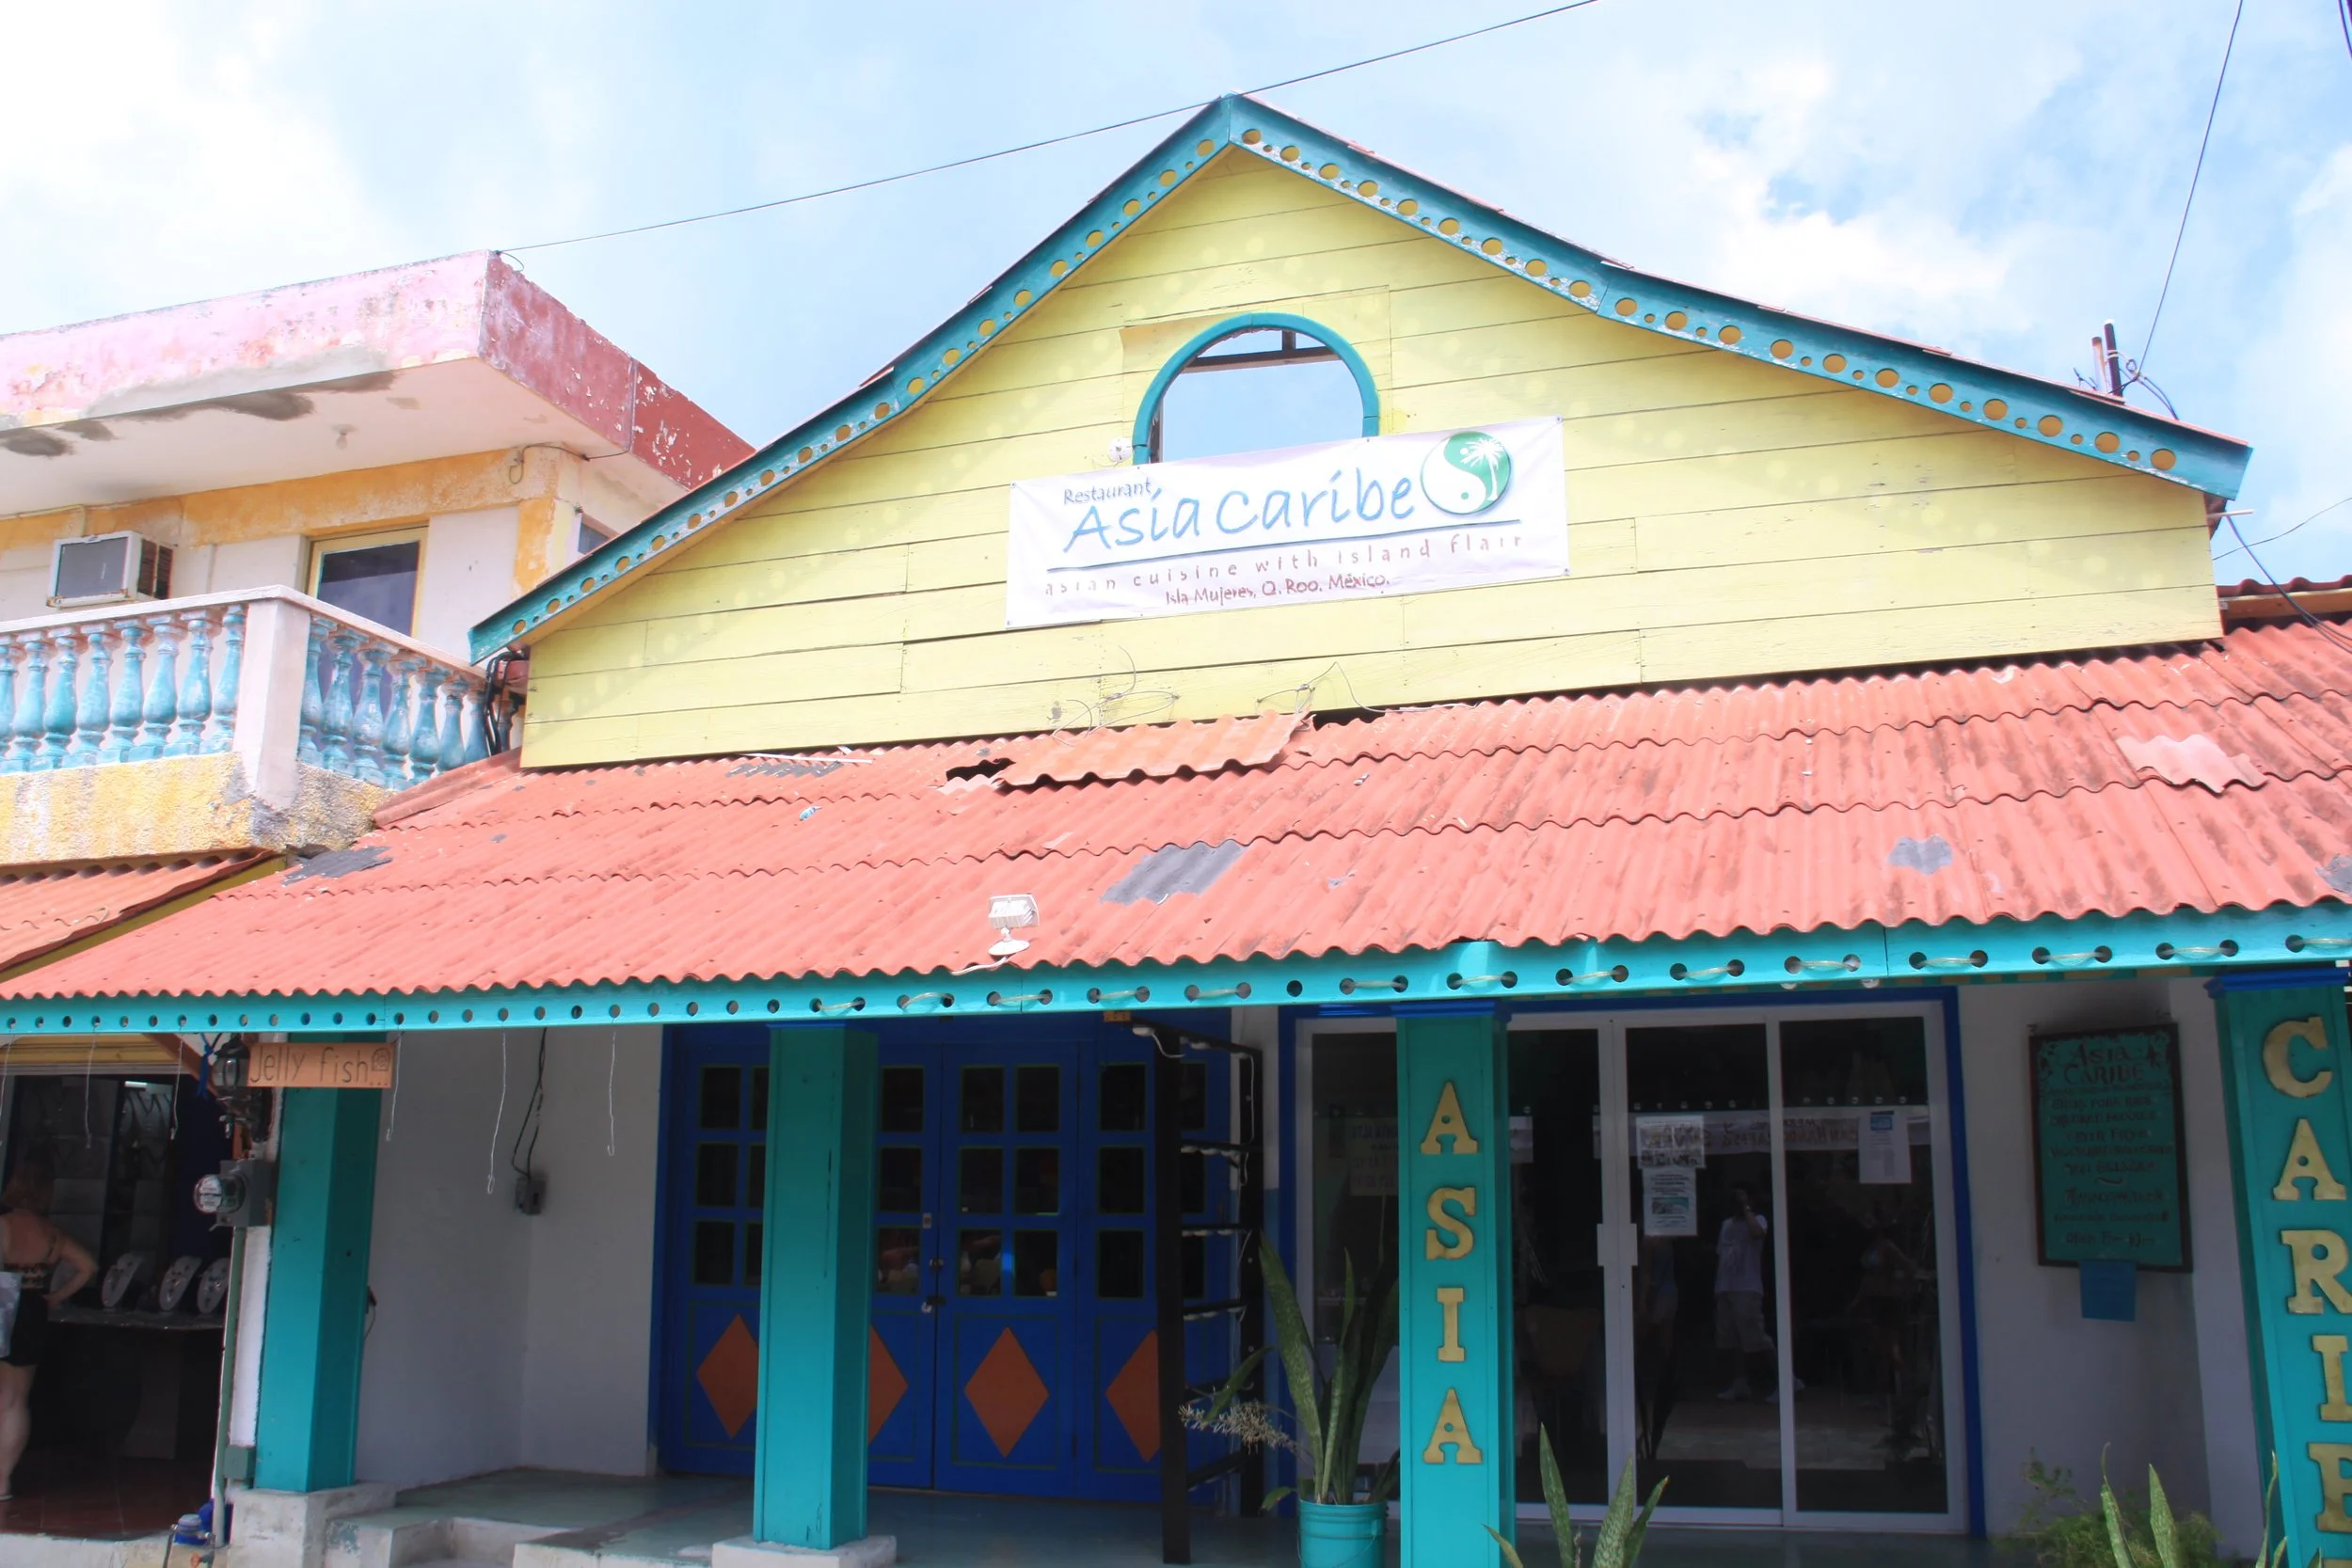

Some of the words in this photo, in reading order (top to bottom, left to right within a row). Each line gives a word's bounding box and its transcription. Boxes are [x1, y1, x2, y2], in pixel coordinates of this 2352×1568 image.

[1063, 477, 1152, 505] Restaurant
[1045, 578, 1117, 596] asian
[1133, 563, 1238, 587] cuisine
[1255, 549, 1317, 573] with
[1338, 539, 1430, 564] island
[1450, 532, 1522, 554] flair
[1166, 589, 1189, 606] Isla
[249, 1045, 307, 1084] Jelly
